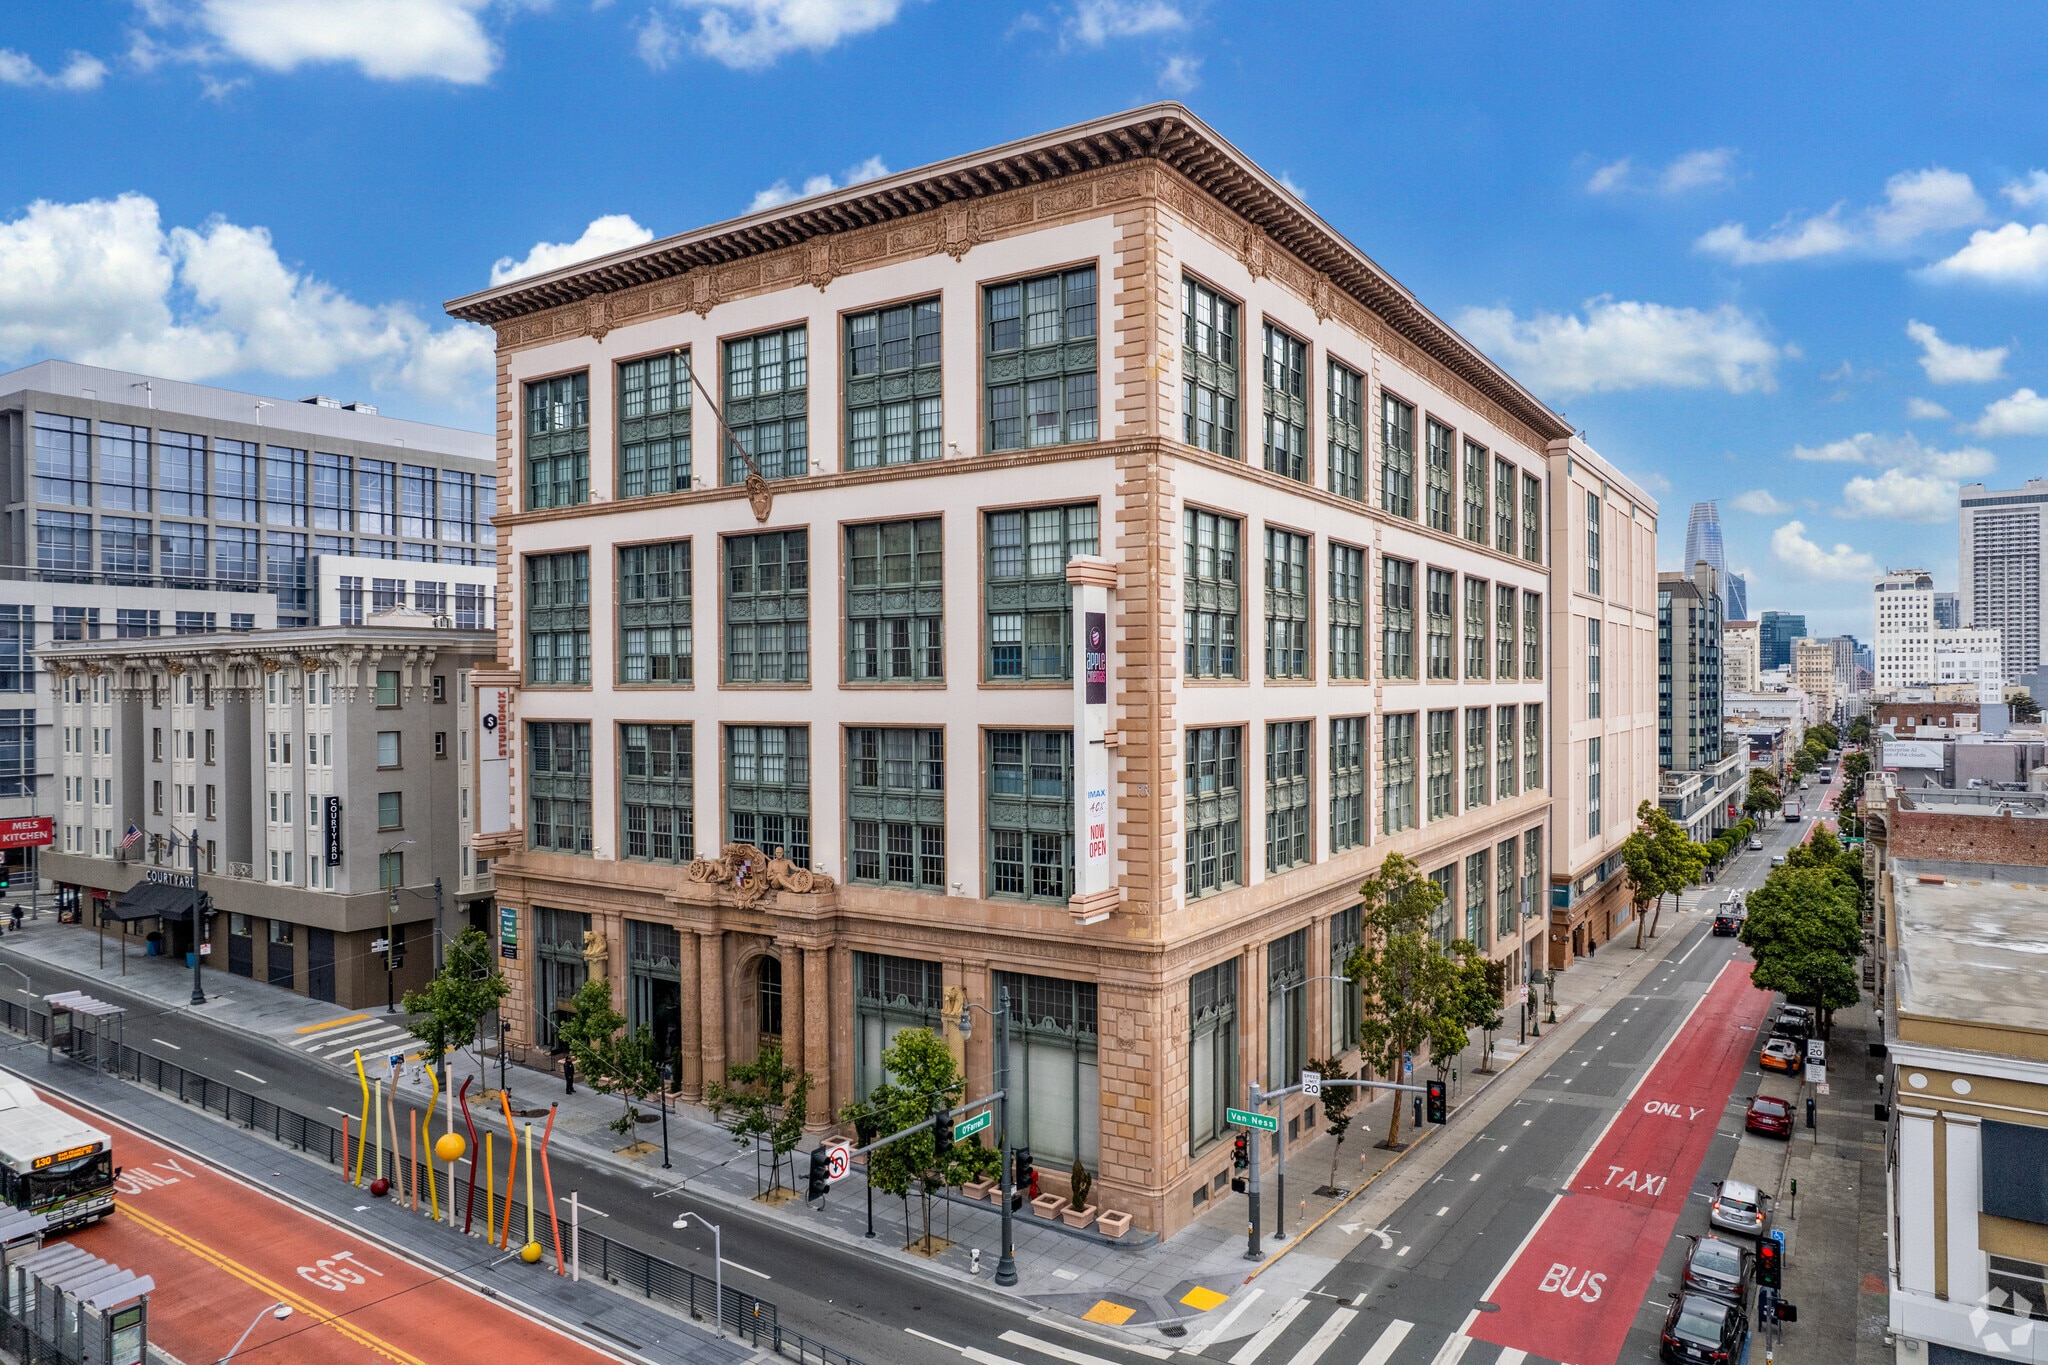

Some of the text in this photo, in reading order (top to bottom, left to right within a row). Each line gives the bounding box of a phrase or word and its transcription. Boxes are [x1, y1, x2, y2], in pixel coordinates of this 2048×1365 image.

[498, 691, 507, 756] STUDIOMIX
[1088, 789, 1106, 798] IMAX
[12, 821, 39, 830] MELS
[330, 798, 338, 860] COURTYARD
[1090, 823, 1105, 840] NOW
[2, 831, 48, 842] KITCHEN
[1089, 840, 1106, 858] OPEN
[1305, 1084, 1318, 1094] 20
[1644, 1101, 1705, 1121] ONLY
[962, 1118, 984, 1135] O'Farrell
[1231, 1112, 1274, 1128] Van Ness
[35, 1156, 52, 1169] 130
[113, 1158, 196, 1195] ONLY
[1604, 1165, 1668, 1196] TAXI
[297, 1250, 384, 1291] GGT
[1538, 1263, 1607, 1303] BUS
